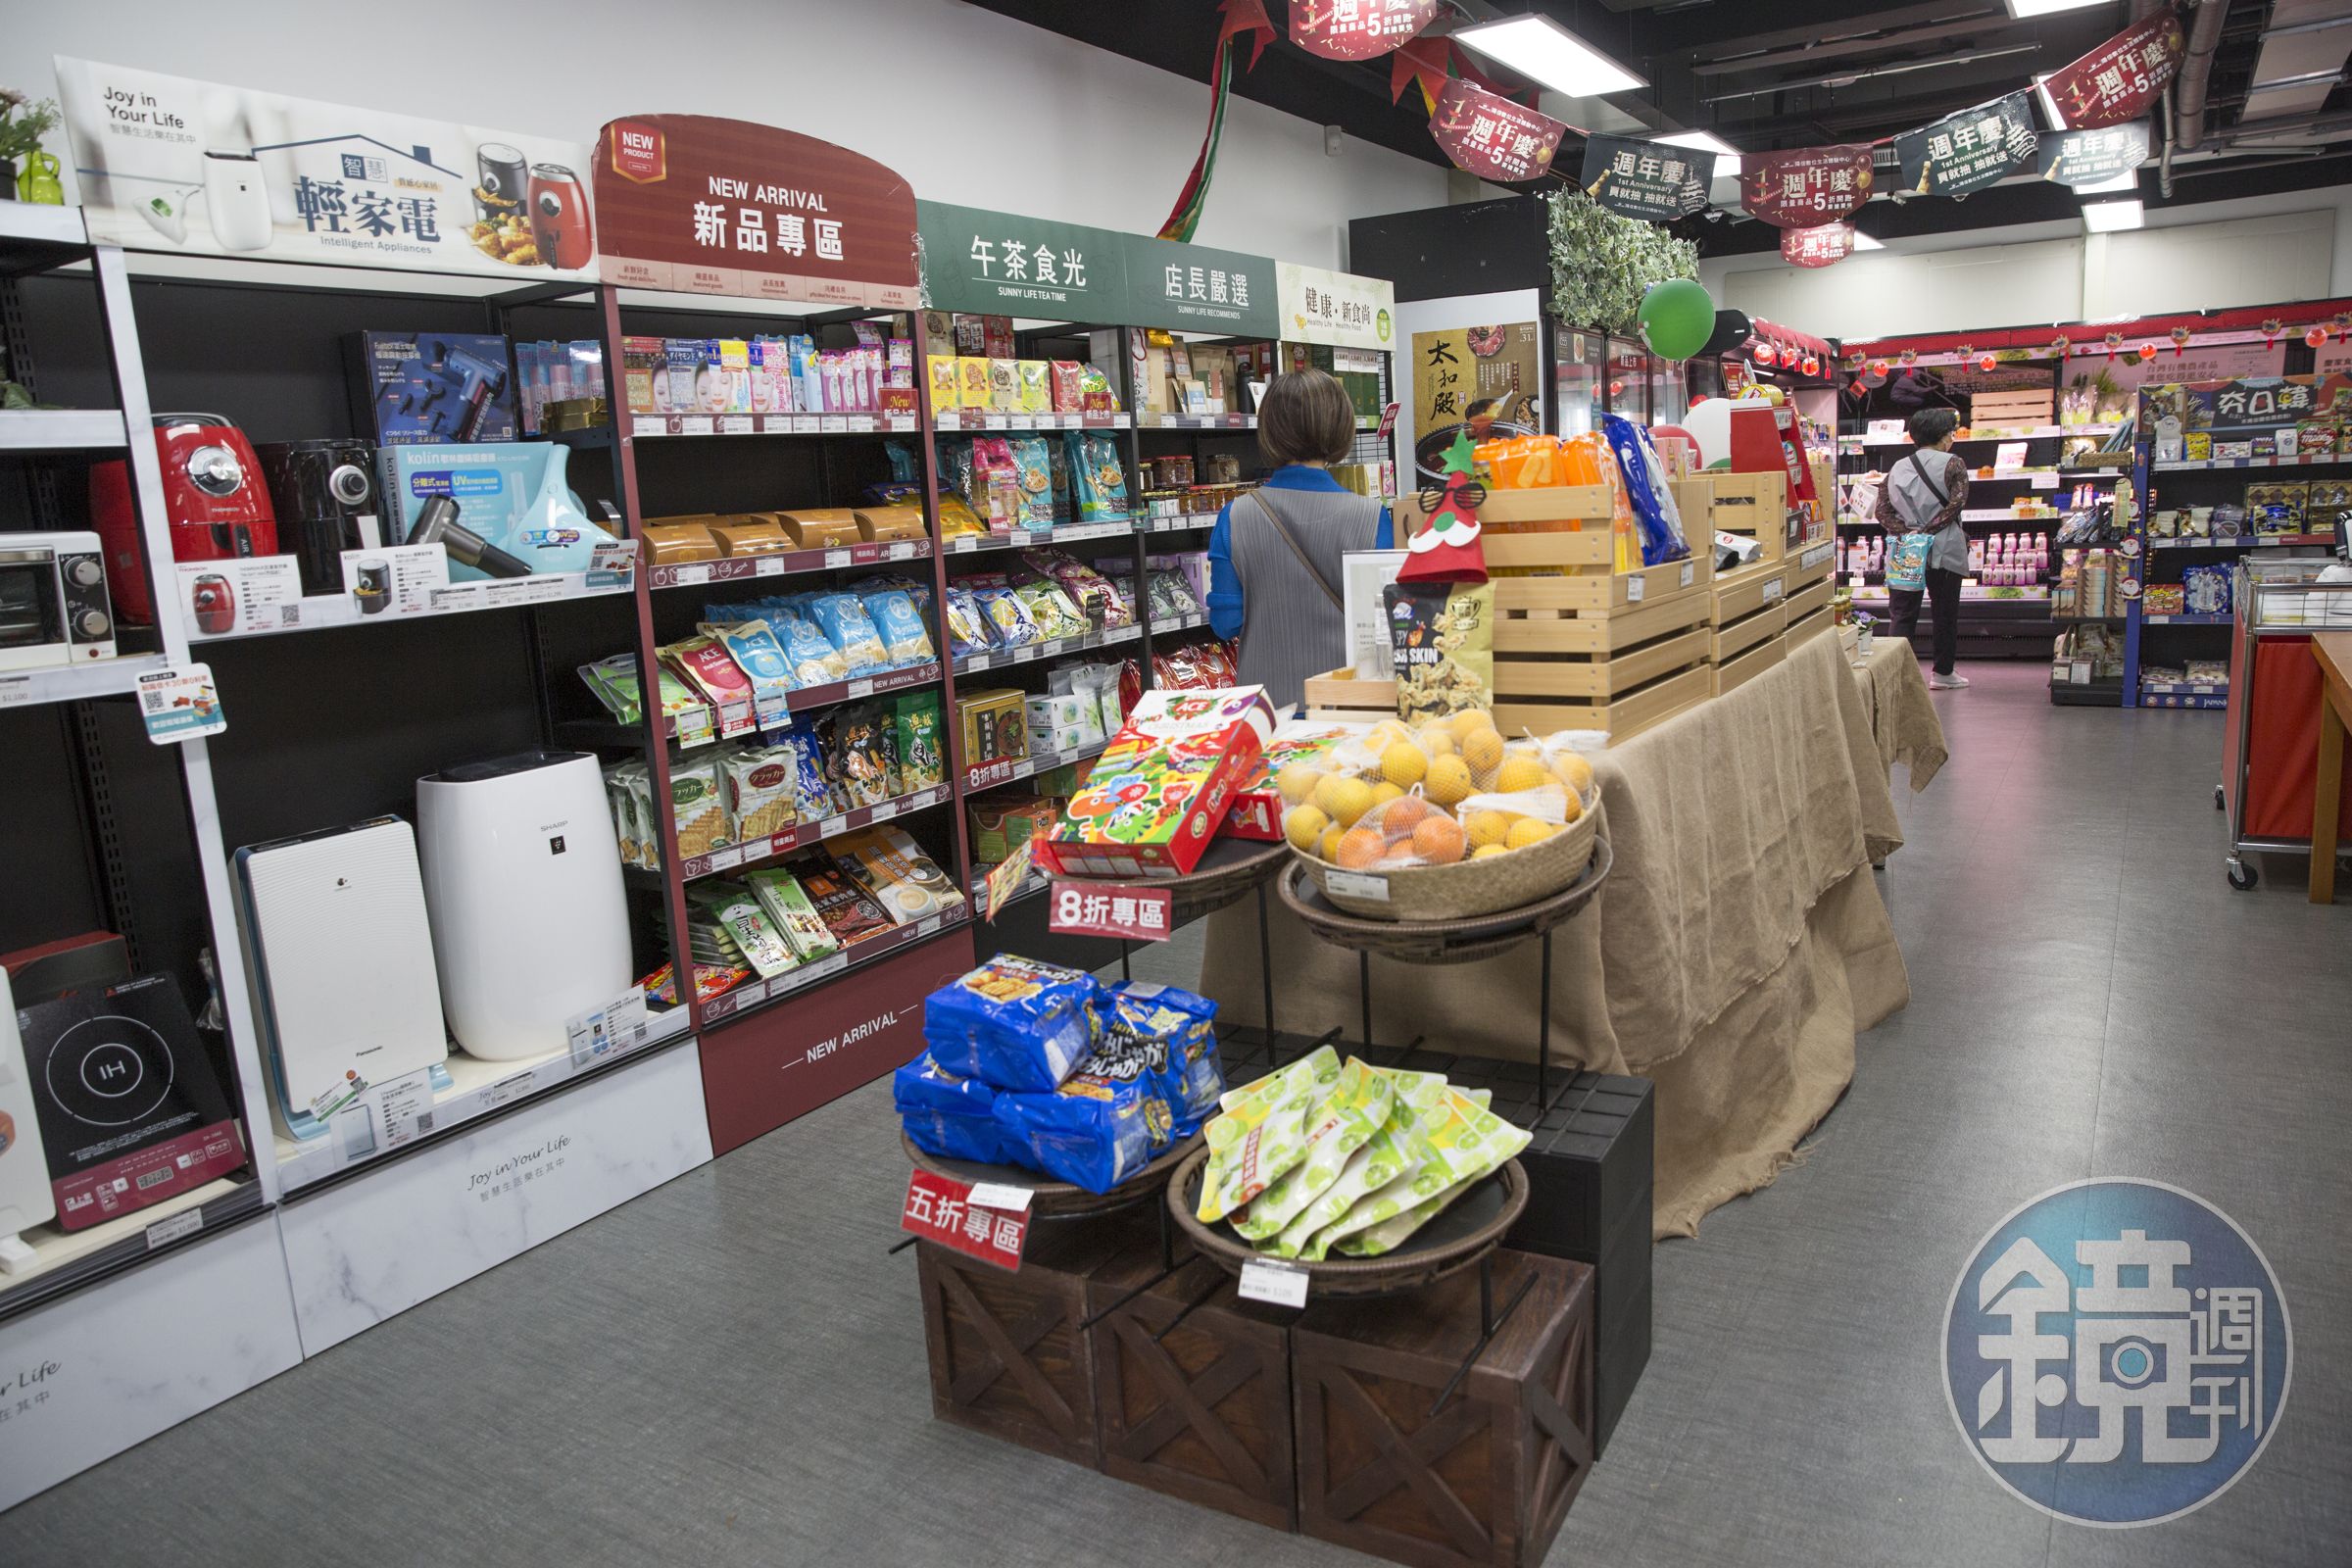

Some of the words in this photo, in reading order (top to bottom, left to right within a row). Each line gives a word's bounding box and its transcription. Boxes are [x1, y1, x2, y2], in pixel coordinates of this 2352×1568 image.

[1367, 13, 1381, 36] 5
[2094, 41, 2167, 100] 週年慶
[2134, 74, 2149, 93] 5
[104, 86, 134, 107] Joy
[141, 92, 157, 107] in
[106, 104, 148, 123] Your
[153, 112, 184, 128] Life
[622, 131, 654, 150] NEW
[1467, 114, 1536, 160] 週年慶
[1929, 116, 2004, 162] 週年慶
[2062, 132, 2125, 158] 週年慶
[623, 148, 654, 160] PRODUCT
[1490, 146, 1506, 165] 5
[1954, 145, 1997, 164] Anniversary
[343, 155, 386, 181] 智慧
[1612, 151, 1686, 185] 週年慶
[710, 175, 748, 200] NEW
[755, 184, 828, 213] ARRIVAL
[1630, 179, 1673, 194] Anniversary
[1782, 167, 1852, 199] 週年慶
[293, 175, 441, 243] 輕家電
[1814, 192, 1826, 211] 5
[694, 201, 844, 261] 新品專區
[320, 236, 373, 249] Intelligent
[377, 241, 432, 254] Appliances
[971, 235, 1087, 286] 午茶食光
[998, 286, 1021, 298] SUNNY
[1023, 289, 1038, 299] LIFE
[1039, 290, 1052, 300] TEA
[1052, 291, 1066, 302] TIME
[1165, 263, 1250, 307] 店長嚴選
[1177, 306, 1196, 315] SUNNY
[1207, 309, 1241, 319] RECOMMENDS
[1428, 340, 1458, 420] 太和殿
[890, 395, 910, 409] New
[1091, 398, 1106, 409] New
[2218, 385, 2310, 416] 夯日韓
[1086, 410, 1110, 419] 新品上市
[407, 452, 439, 465] kolin
[745, 636, 768, 649] ACE
[698, 648, 721, 662] ACE
[1409, 648, 1438, 662] SKIN
[874, 679, 888, 689] NEW
[890, 673, 915, 686] ARRIVAL
[1175, 700, 1208, 712] ACE
[970, 760, 1010, 787] 8折專區
[540, 820, 568, 832] SHARP
[1058, 890, 1165, 929] 8折專區
[902, 928, 915, 939] NEW
[807, 1038, 837, 1064] NEW
[842, 1010, 898, 1049] ARRIVAL
[356, 1045, 383, 1057] Panasonic
[1104, 1032, 1165, 1067] みじゃが
[99, 1060, 126, 1080] IH
[1082, 1054, 1142, 1078] みじゃが
[466, 1172, 490, 1191] Joy
[491, 1163, 512, 1179] in
[512, 1147, 544, 1171] Your
[547, 1135, 571, 1155] Life
[906, 1185, 1024, 1255] 五折專區
[20, 1360, 62, 1388] Life
